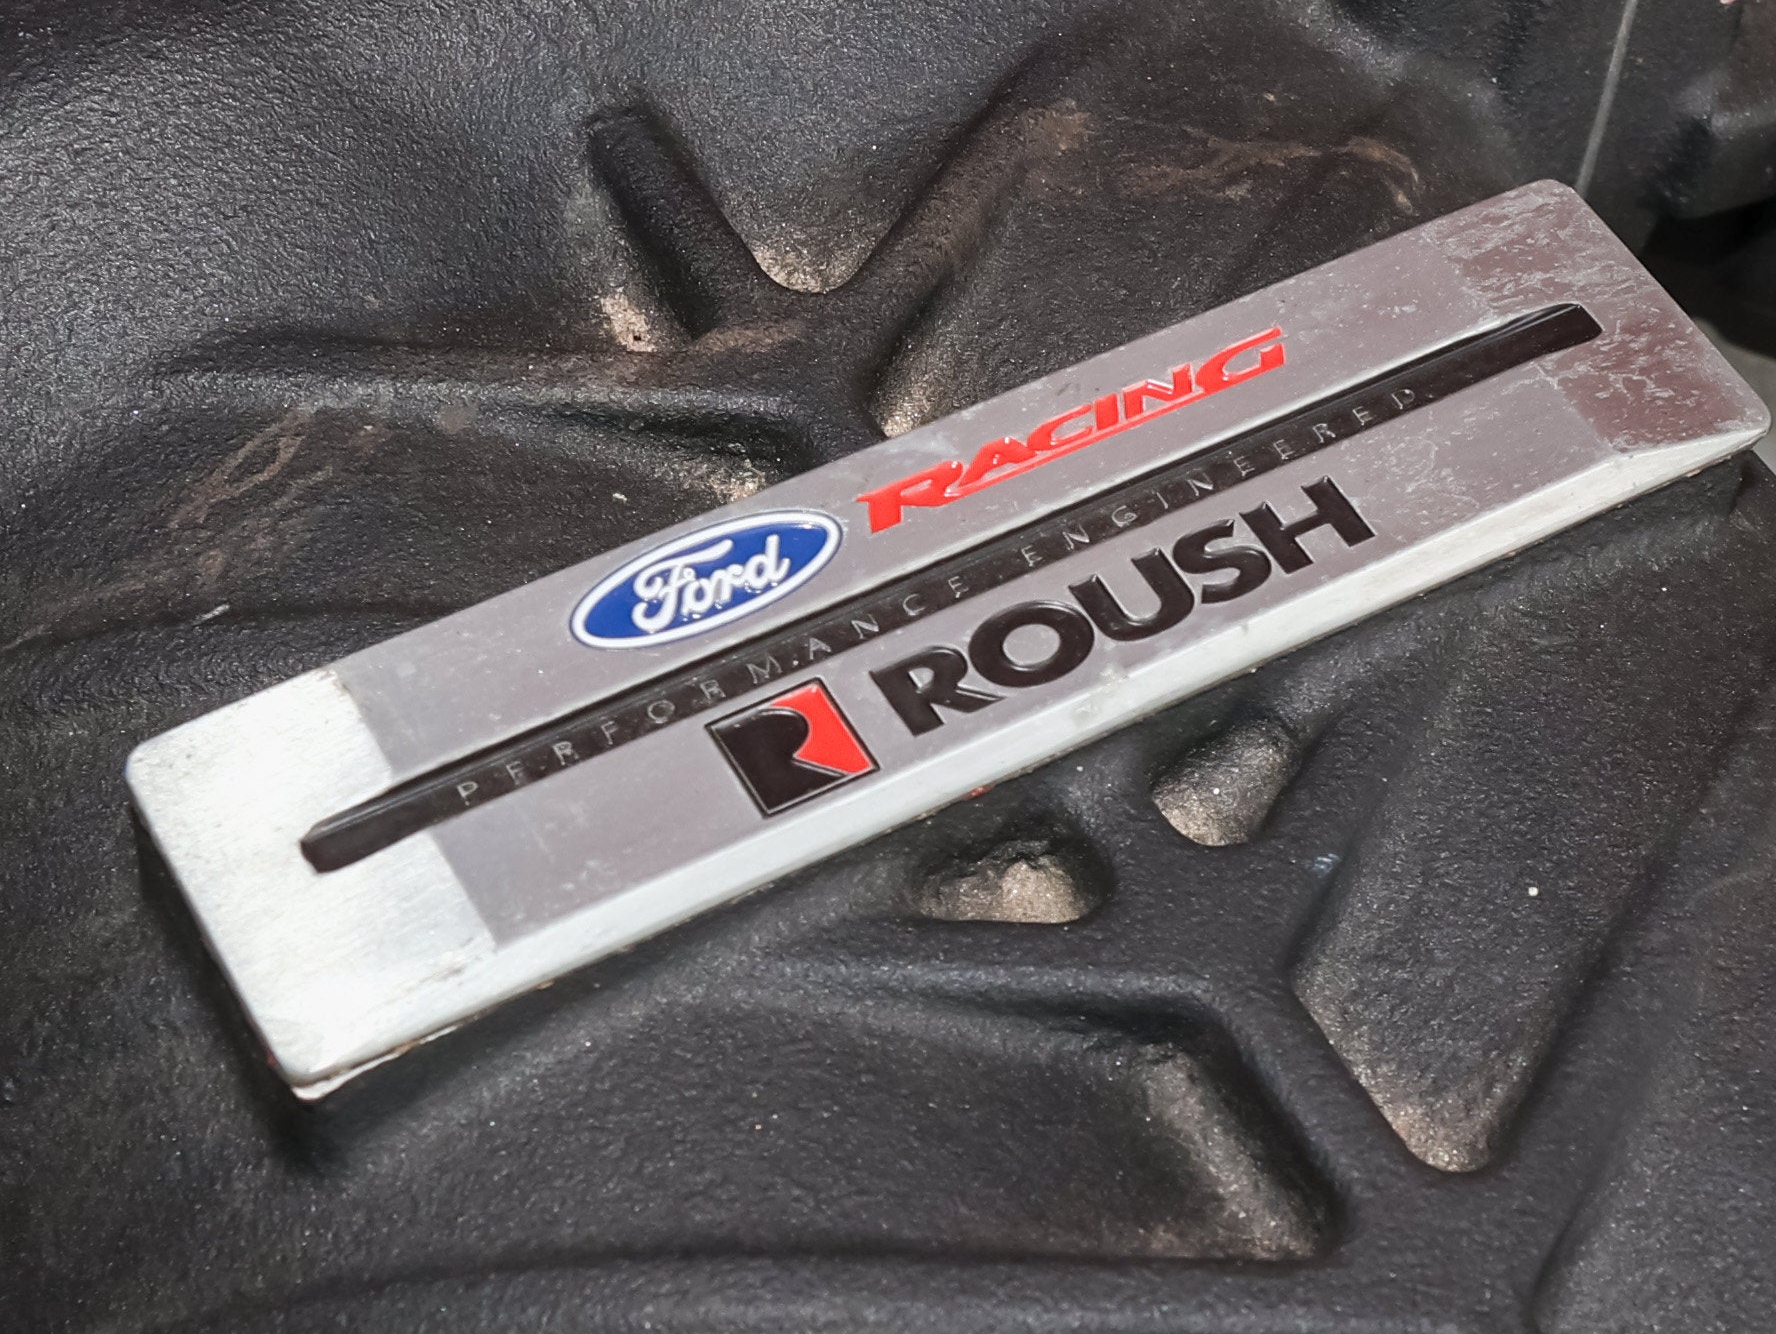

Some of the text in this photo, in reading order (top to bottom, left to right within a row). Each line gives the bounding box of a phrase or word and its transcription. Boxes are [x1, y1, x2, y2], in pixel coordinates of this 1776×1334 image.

[456, 385, 1417, 808] PERFORMANCE ENGINEERED
[630, 327, 1287, 635] Ford RACING
[867, 474, 1377, 737] ROUSH
